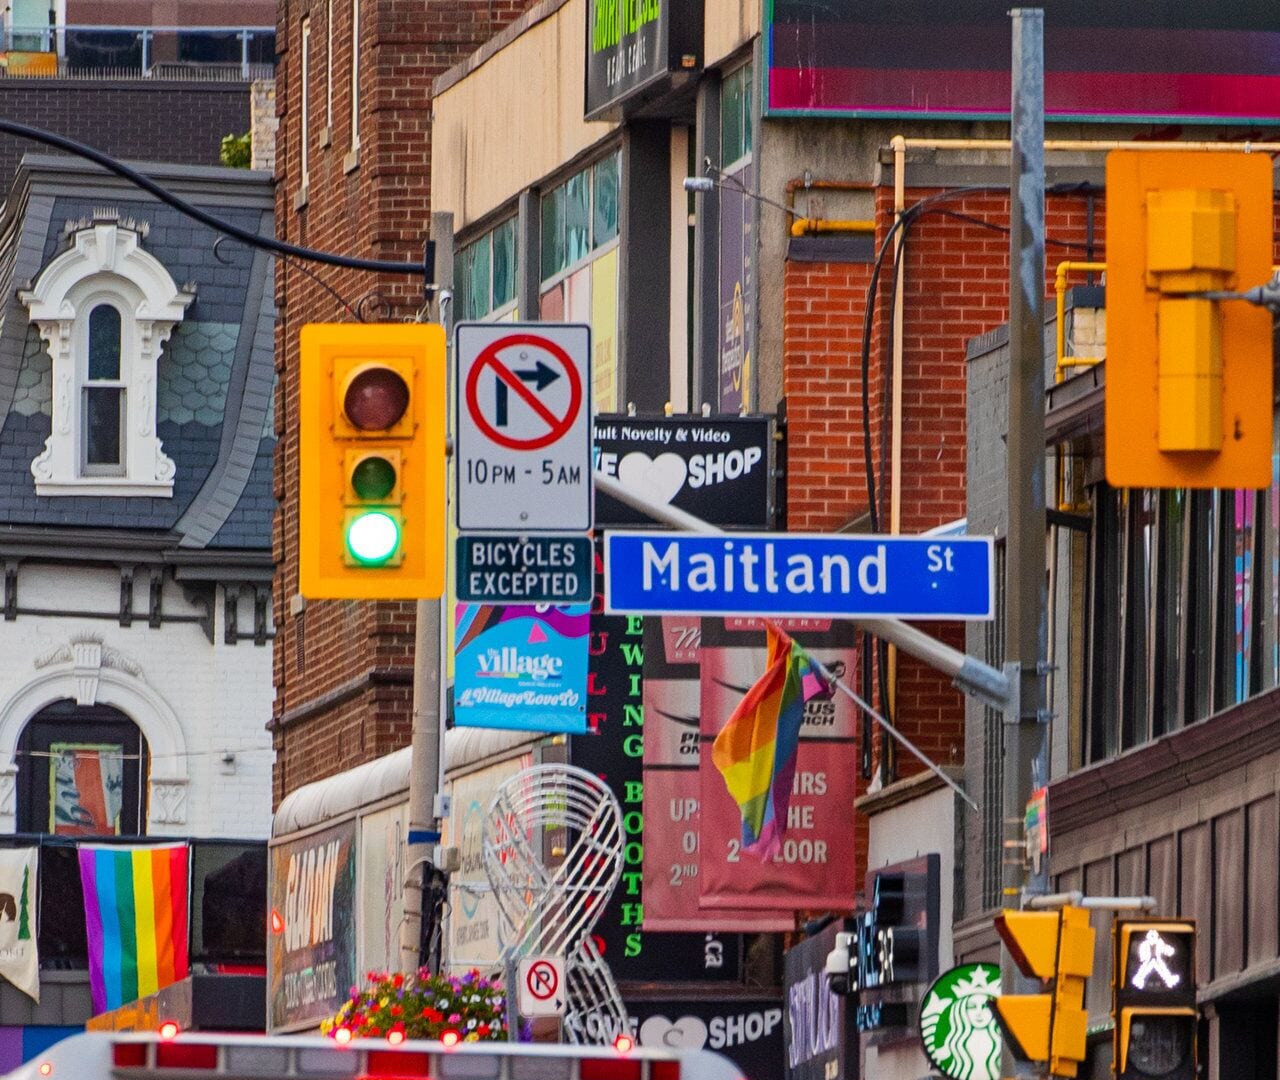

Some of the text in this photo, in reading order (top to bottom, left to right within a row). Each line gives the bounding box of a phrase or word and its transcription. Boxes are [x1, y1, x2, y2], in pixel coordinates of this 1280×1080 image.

[621, 427, 671, 443] Novelty
[675, 428, 688, 442] &
[691, 427, 730, 442] Video
[688, 446, 761, 488] SHOP
[472, 543, 576, 567] BICYCLES
[642, 541, 954, 595] Maitland St
[470, 572, 579, 596] EXCEPTED
[734, 618, 822, 627] BRWERY
[477, 647, 563, 682] village
[620, 615, 643, 757] EWING
[788, 806, 815, 829] HE
[774, 839, 827, 864] LOOR
[709, 1008, 782, 1049] SHOP
